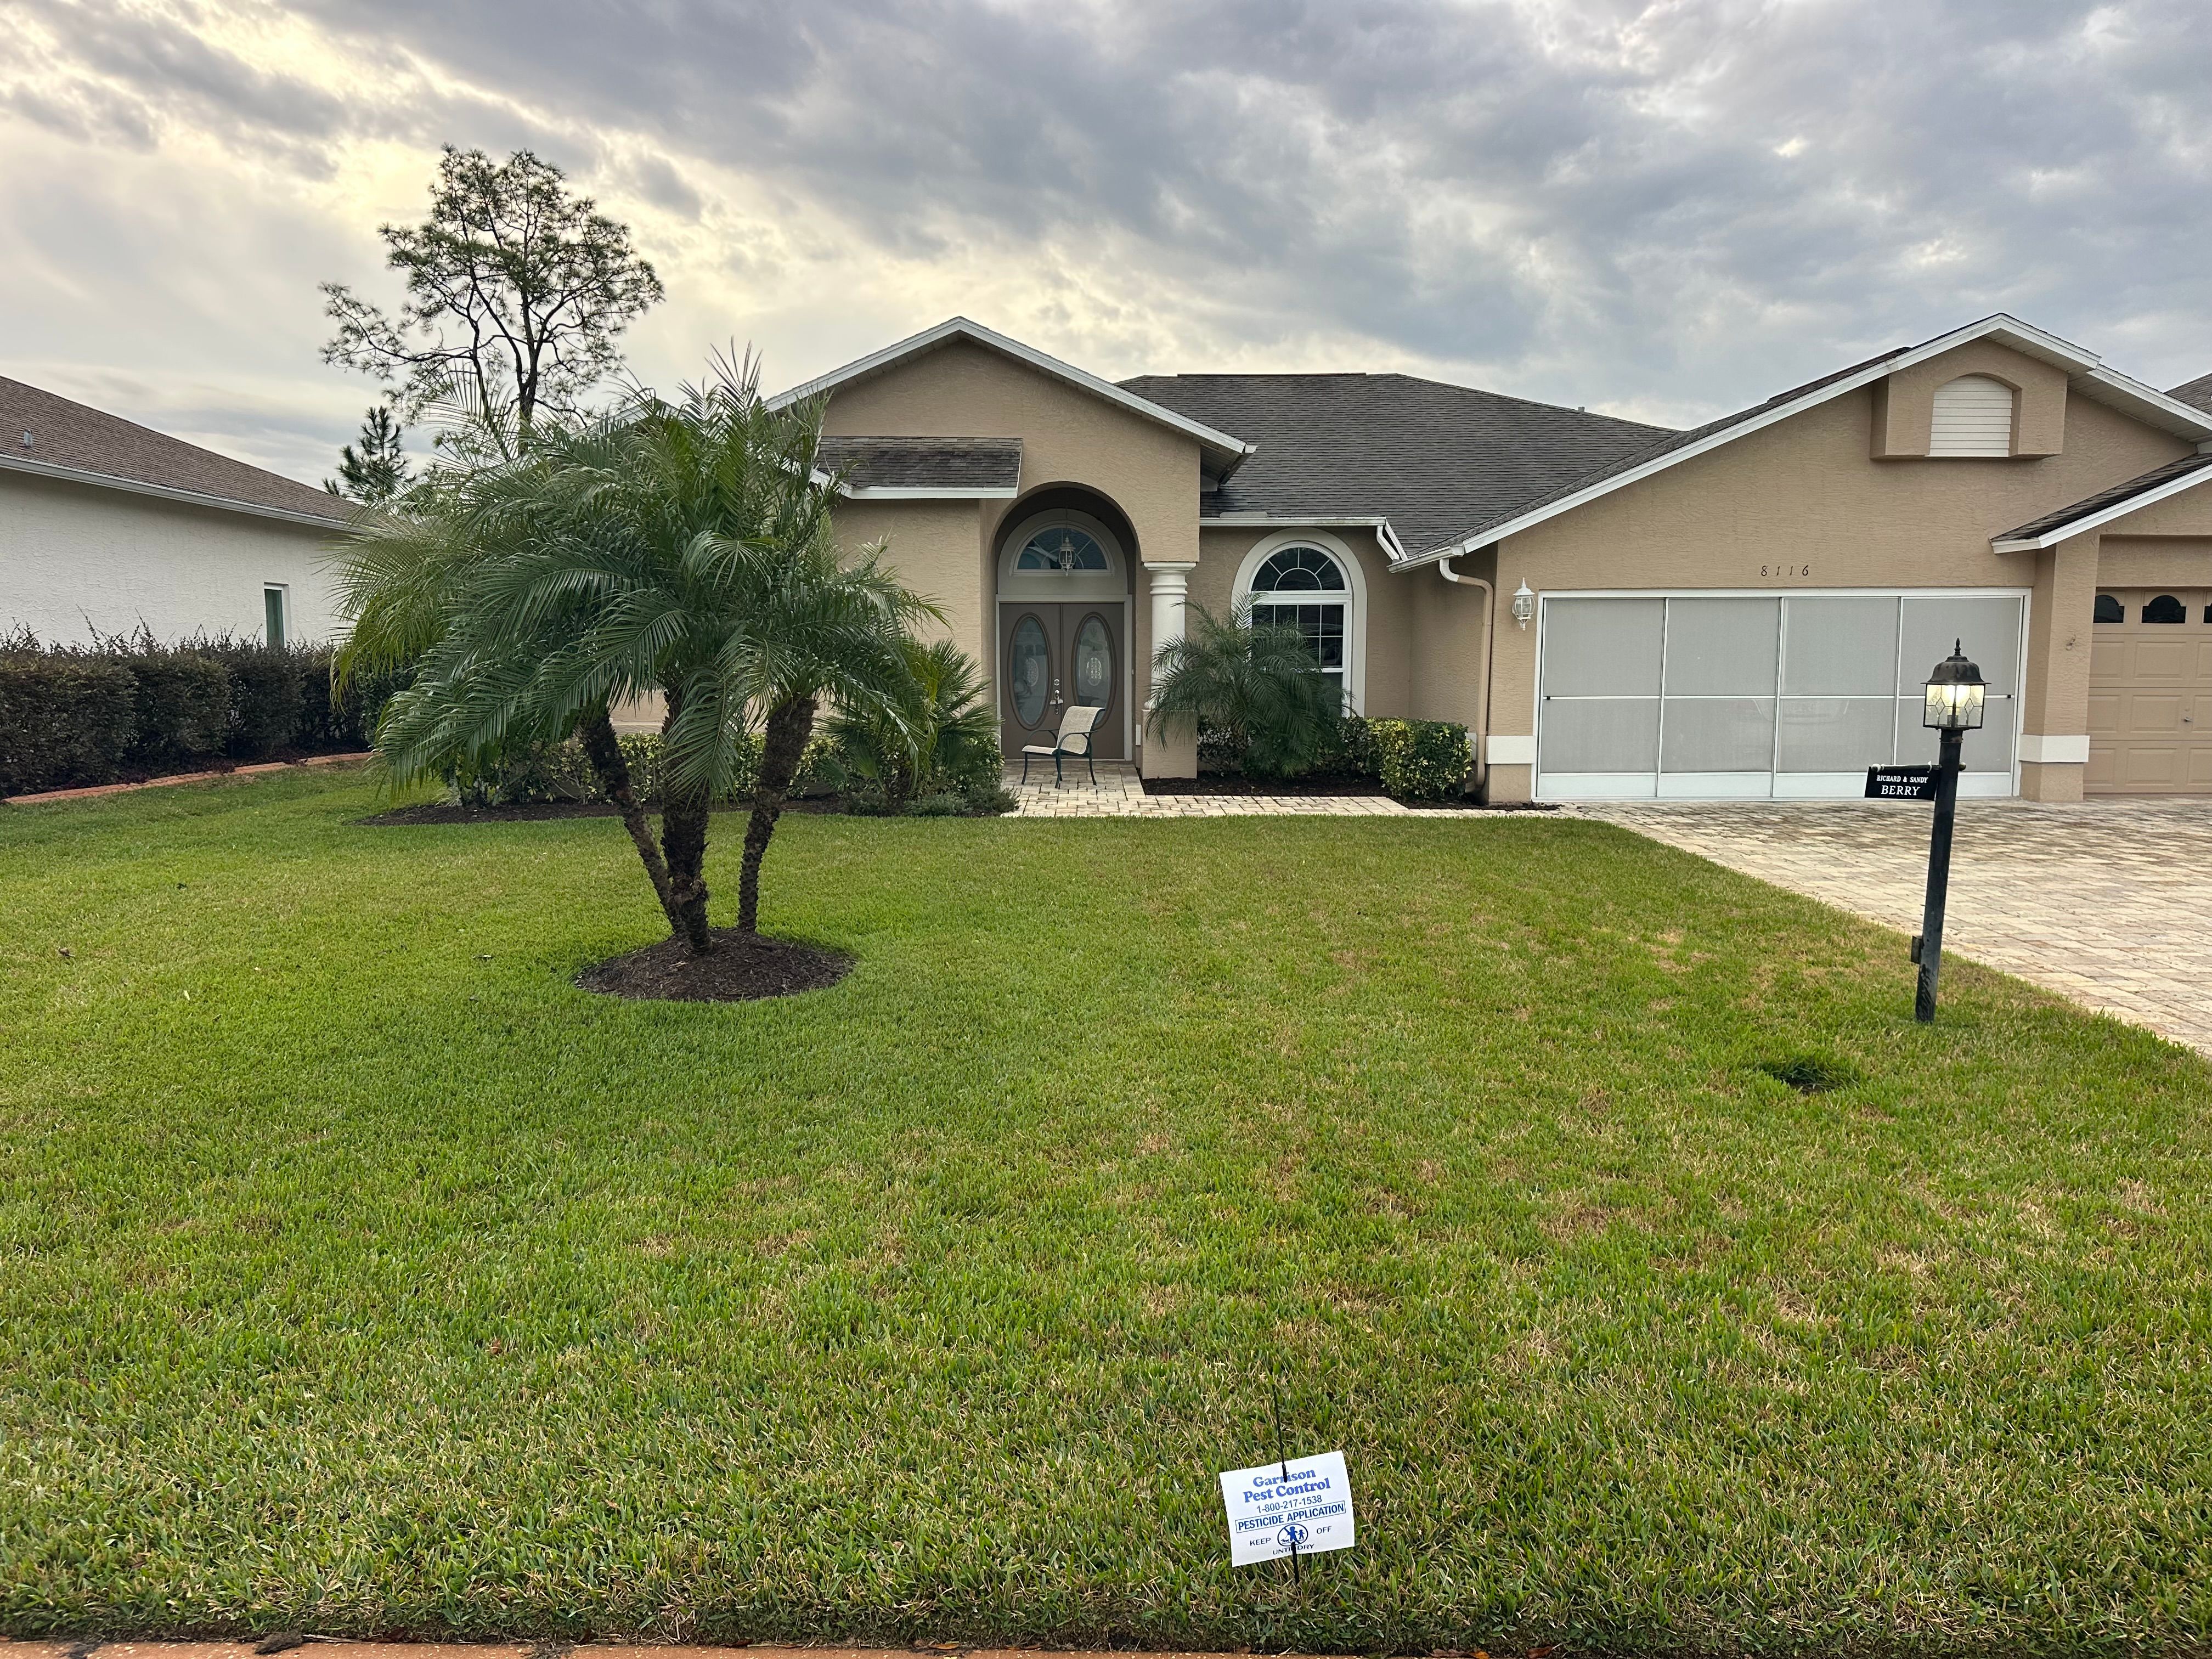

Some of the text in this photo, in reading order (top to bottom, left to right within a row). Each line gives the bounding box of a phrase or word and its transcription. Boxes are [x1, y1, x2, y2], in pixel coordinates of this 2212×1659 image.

[1761, 565, 1809, 577] 8116
[1881, 785, 1921, 796] BERRY
[1243, 1477, 1331, 1503] Pest Control
[1257, 1495, 1323, 1514] 1-800-217-1538
[1238, 1503, 1344, 1531] PESTICIDE APPLICATION
[1250, 1526, 1333, 1547] KEEP OFF
